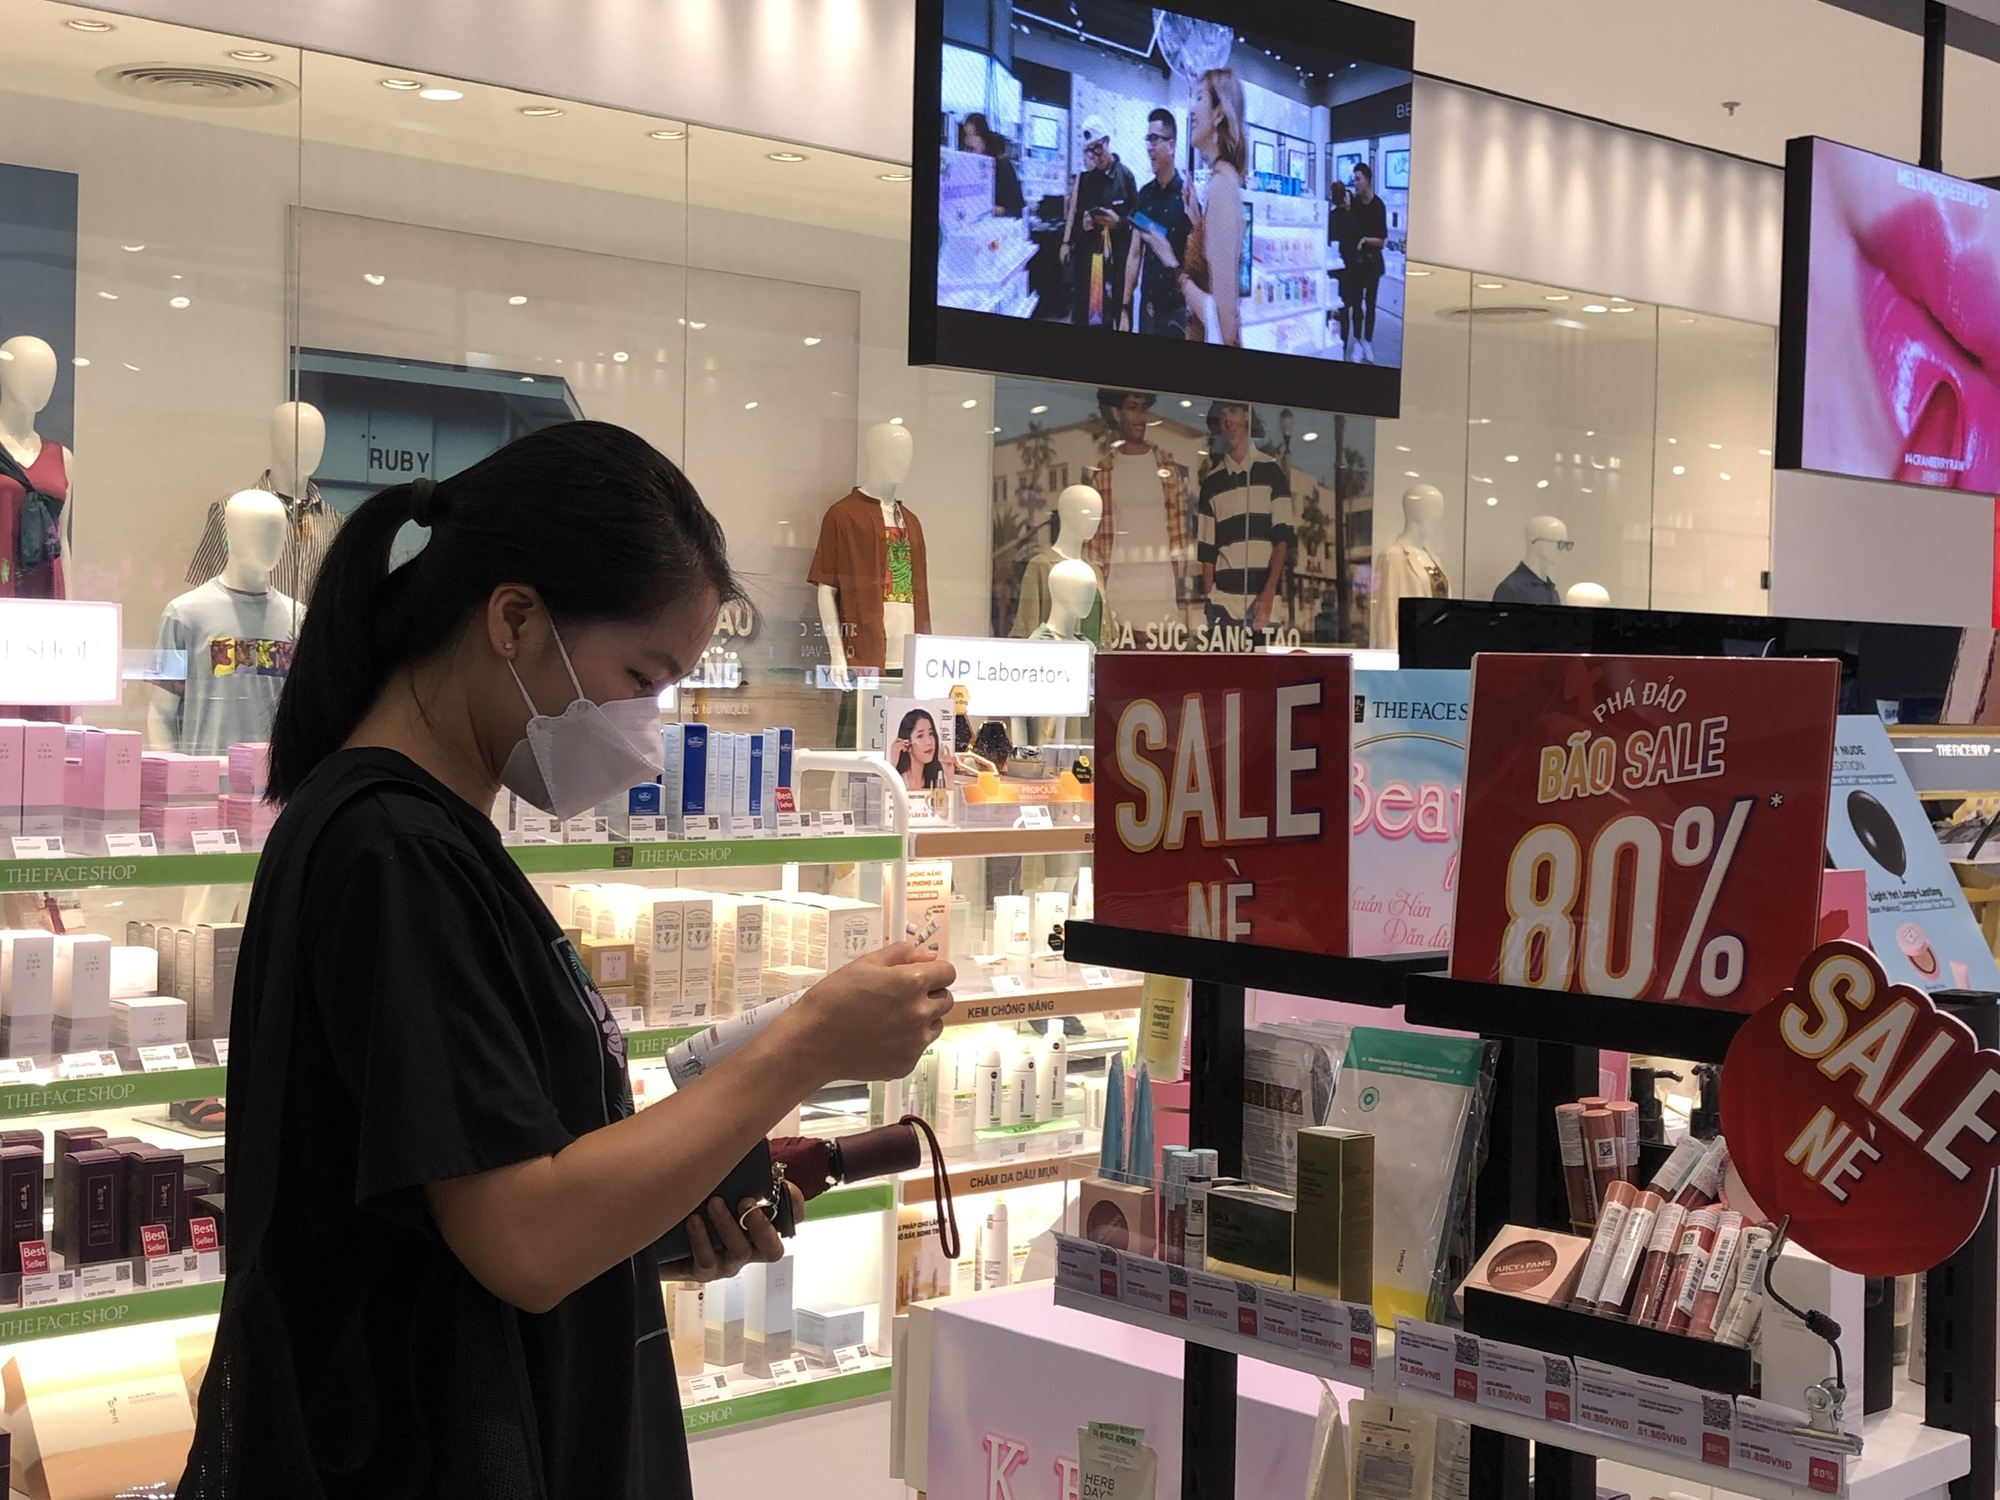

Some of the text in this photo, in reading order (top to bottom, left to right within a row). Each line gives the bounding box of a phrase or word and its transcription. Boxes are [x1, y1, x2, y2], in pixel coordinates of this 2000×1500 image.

[369, 447, 430, 473] RUBY
[1145, 615, 1188, 651] SỨC
[1197, 617, 1253, 652] SÁNG
[926, 659, 1072, 683] CNP Laboratory
[1592, 676, 1687, 723] PHÁ ĐẢO
[1840, 745, 1866, 756] NUDE
[1115, 681, 1323, 854] SALE
[1537, 716, 1728, 804] BÃO SALE
[1188, 857, 1254, 942] NÈ
[968, 1006, 989, 1018] KEM
[1780, 954, 2000, 1180] SALE
[1784, 1105, 1881, 1201] NÈ
[1001, 1172, 1014, 1183] DA
[144, 1229, 167, 1241] Best
[193, 1222, 215, 1234] Best
[147, 1242, 167, 1252] Seller
[196, 1236, 215, 1246] Seller
[23, 1245, 46, 1257] Best
[26, 1258, 46, 1269] Seller
[1495, 1263, 1520, 1273] JUICY
[1526, 1260, 1551, 1269] PANG
[984, 1433, 1028, 1500] K
[1812, 1467, 1834, 1481] 80%
[1085, 1472, 1115, 1490] HERB
[1083, 1484, 1106, 1499] DAY
